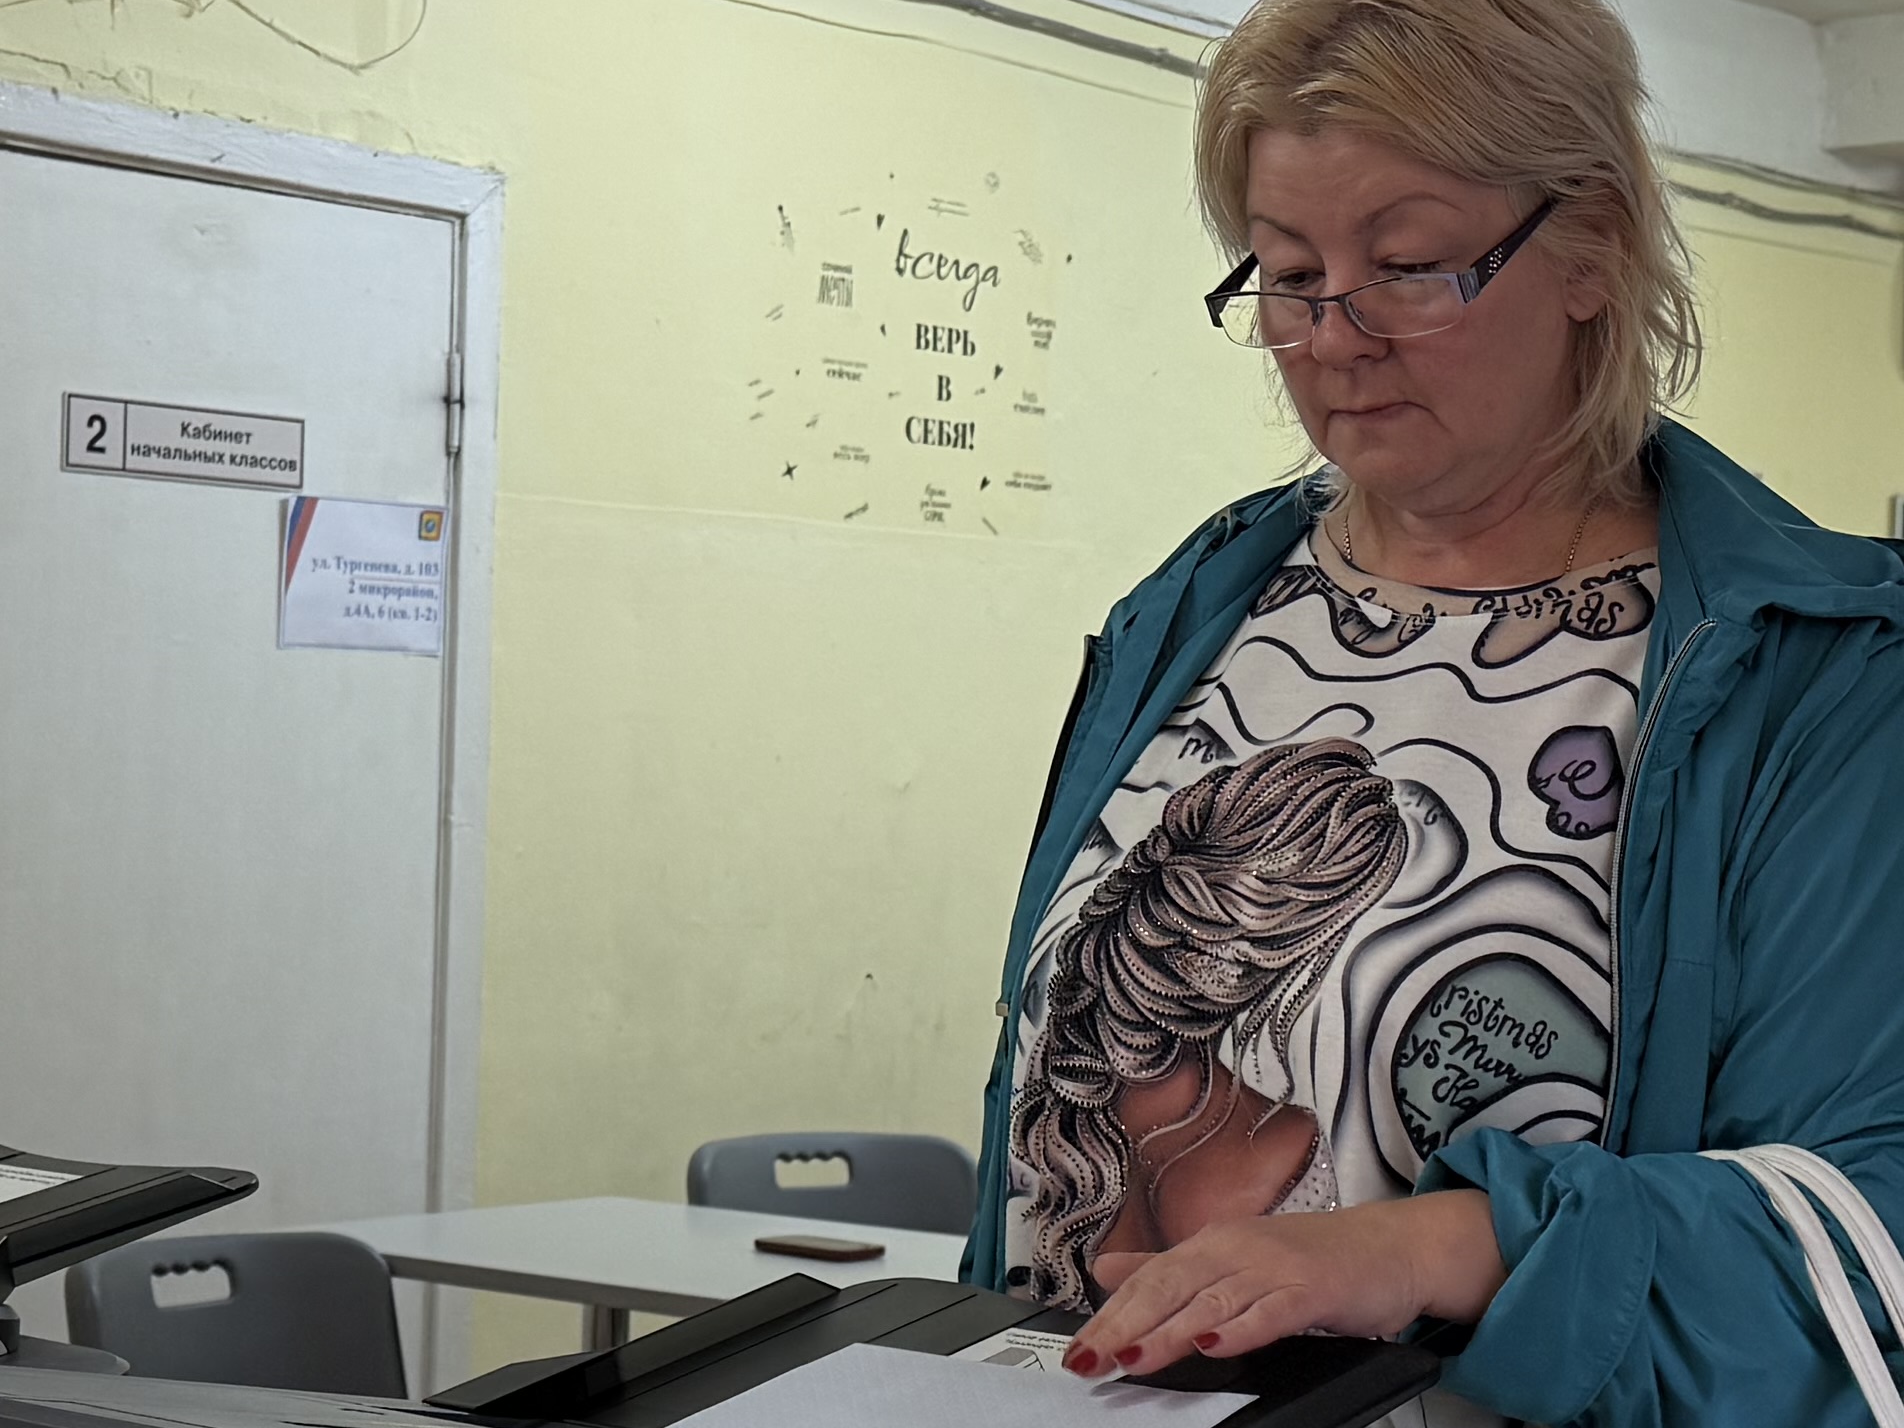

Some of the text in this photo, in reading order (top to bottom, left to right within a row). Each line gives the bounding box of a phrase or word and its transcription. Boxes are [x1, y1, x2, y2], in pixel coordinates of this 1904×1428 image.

[895, 228, 1001, 312] всегда
[915, 323, 976, 357] ВЕРЬ
[937, 374, 952, 402] В
[86, 414, 107, 454] 2
[180, 421, 253, 445] Кабинет
[905, 416, 975, 450] СЕБЯ!
[130, 443, 297, 472] начальных классов
[348, 579, 356, 594] 2
